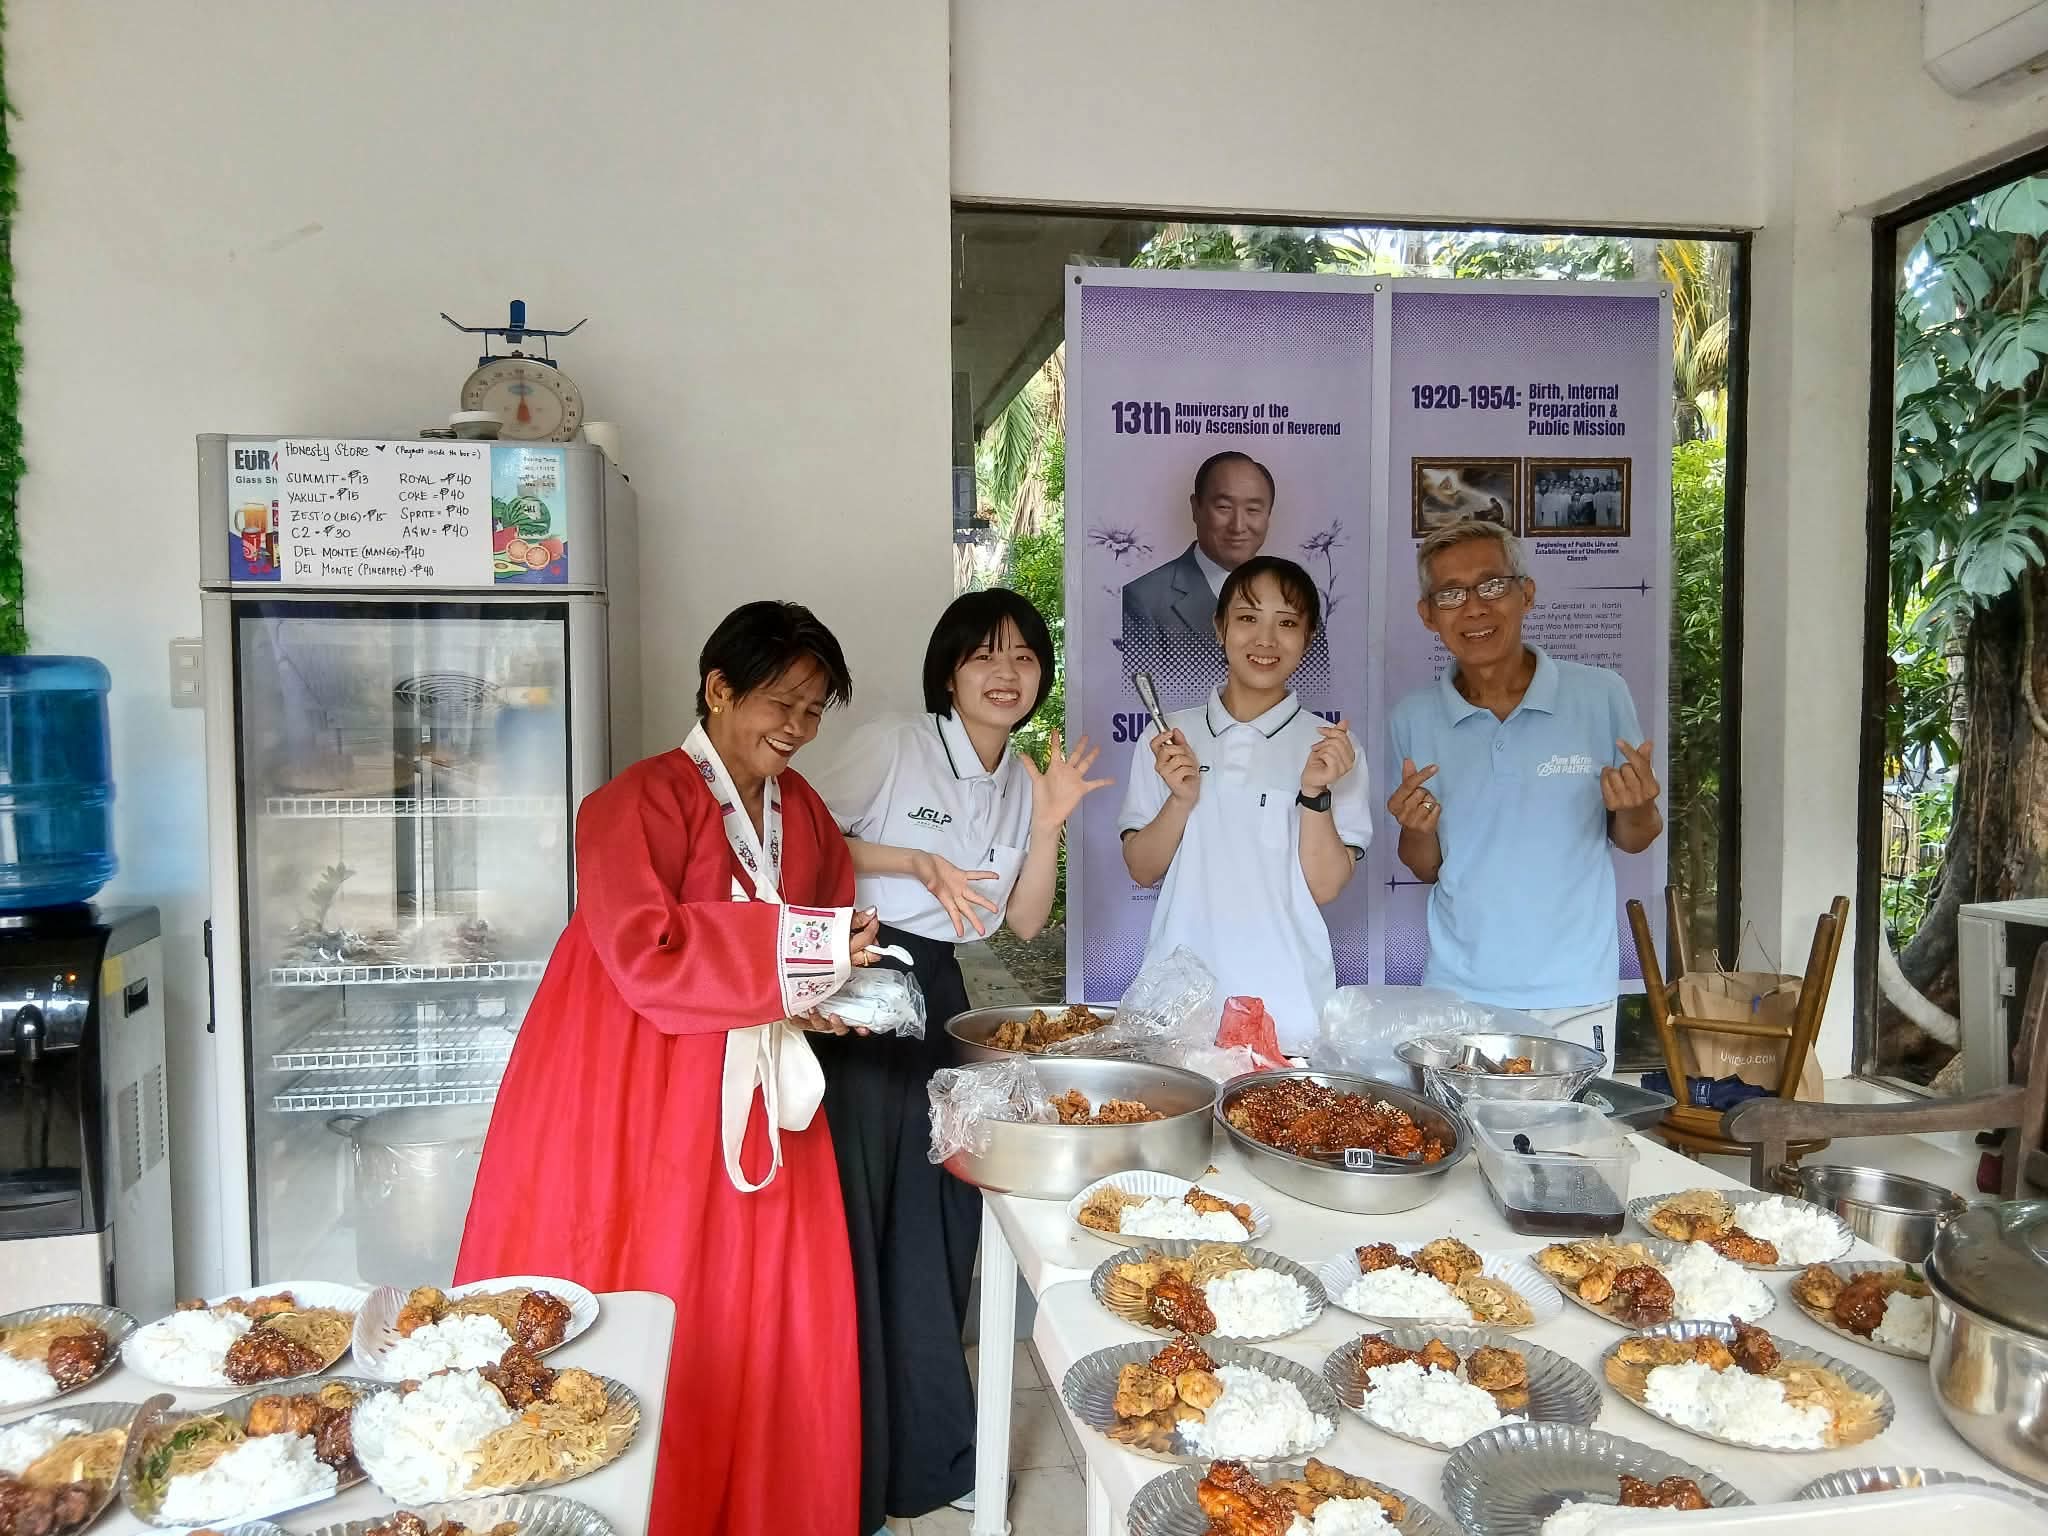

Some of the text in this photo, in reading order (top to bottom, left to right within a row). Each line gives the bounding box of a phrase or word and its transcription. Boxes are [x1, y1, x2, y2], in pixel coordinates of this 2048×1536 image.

[1411, 385, 1522, 409] 1920-1954:
[1529, 384, 1619, 401] Birth, Internal
[1112, 401, 1171, 434] 13th
[1175, 403, 1289, 419] Anniversary of the
[1529, 402, 1618, 418] Preparation &
[1175, 420, 1341, 436] Holy Ascension of Reverend
[1528, 420, 1626, 436] Public Mission
[235, 475, 278, 484] Glass Sh
[1536, 541, 1567, 549] Beginning
[1113, 713, 1152, 742] SU
[907, 806, 953, 826] JGLP
